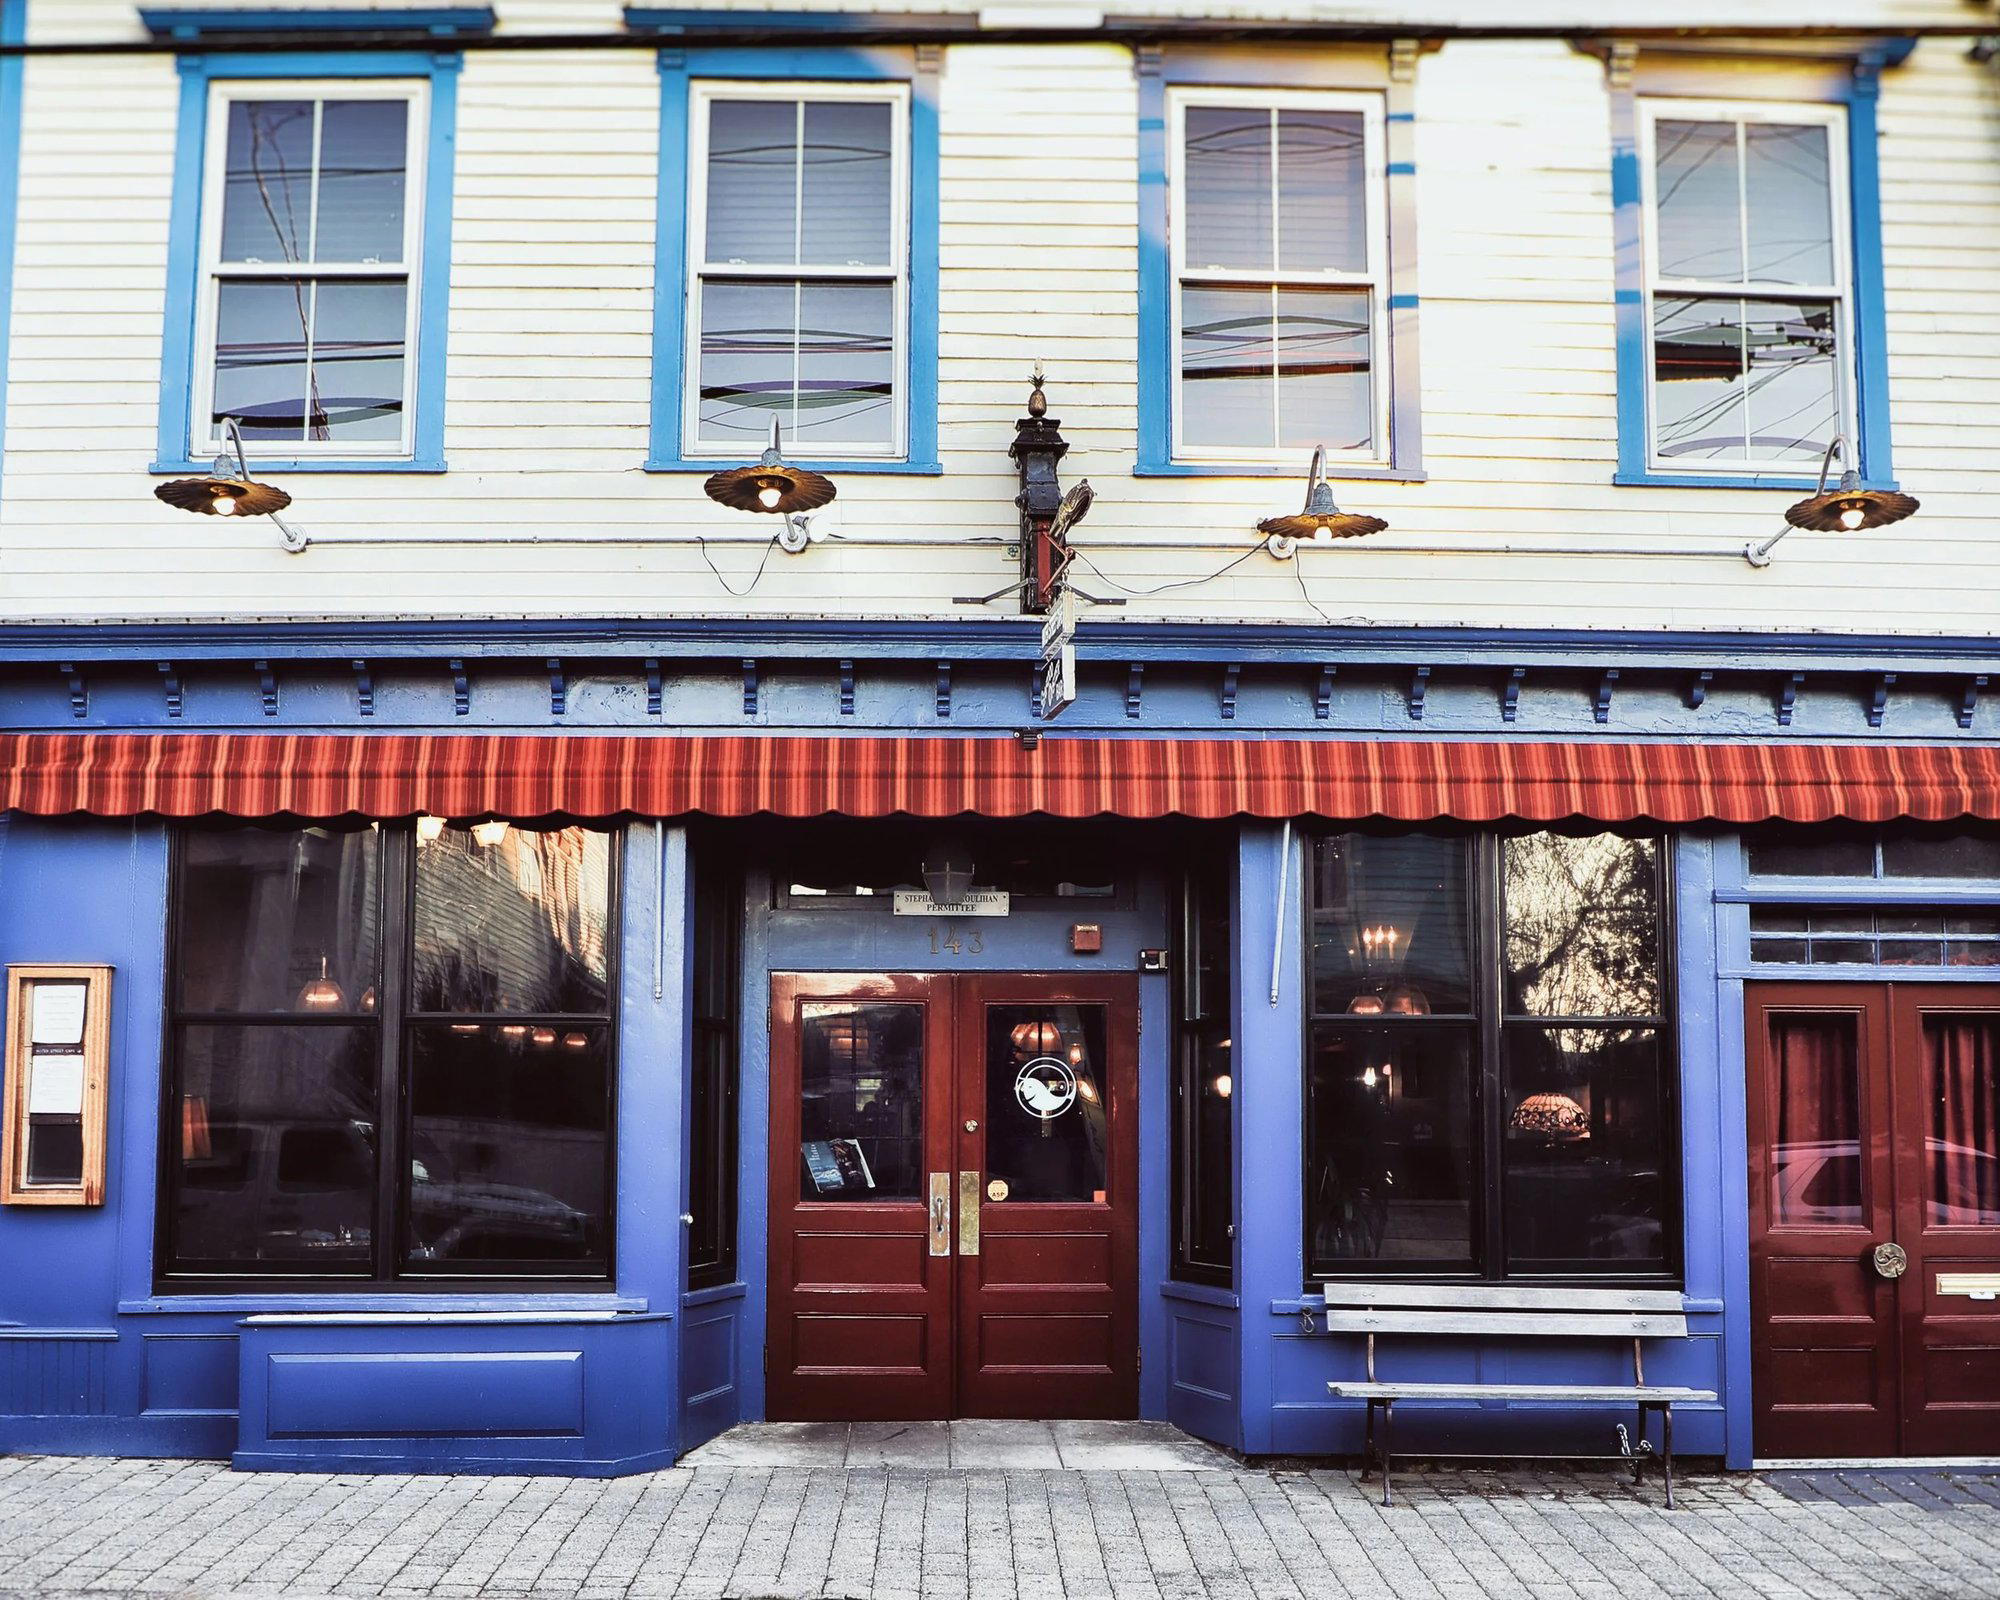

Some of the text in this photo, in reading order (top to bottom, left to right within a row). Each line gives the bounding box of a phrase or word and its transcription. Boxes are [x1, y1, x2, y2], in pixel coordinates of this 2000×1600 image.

[904, 895, 998, 903] STEPHA OULIHAN
[926, 904, 977, 912] PERMITTEE
[928, 926, 984, 954] 143
